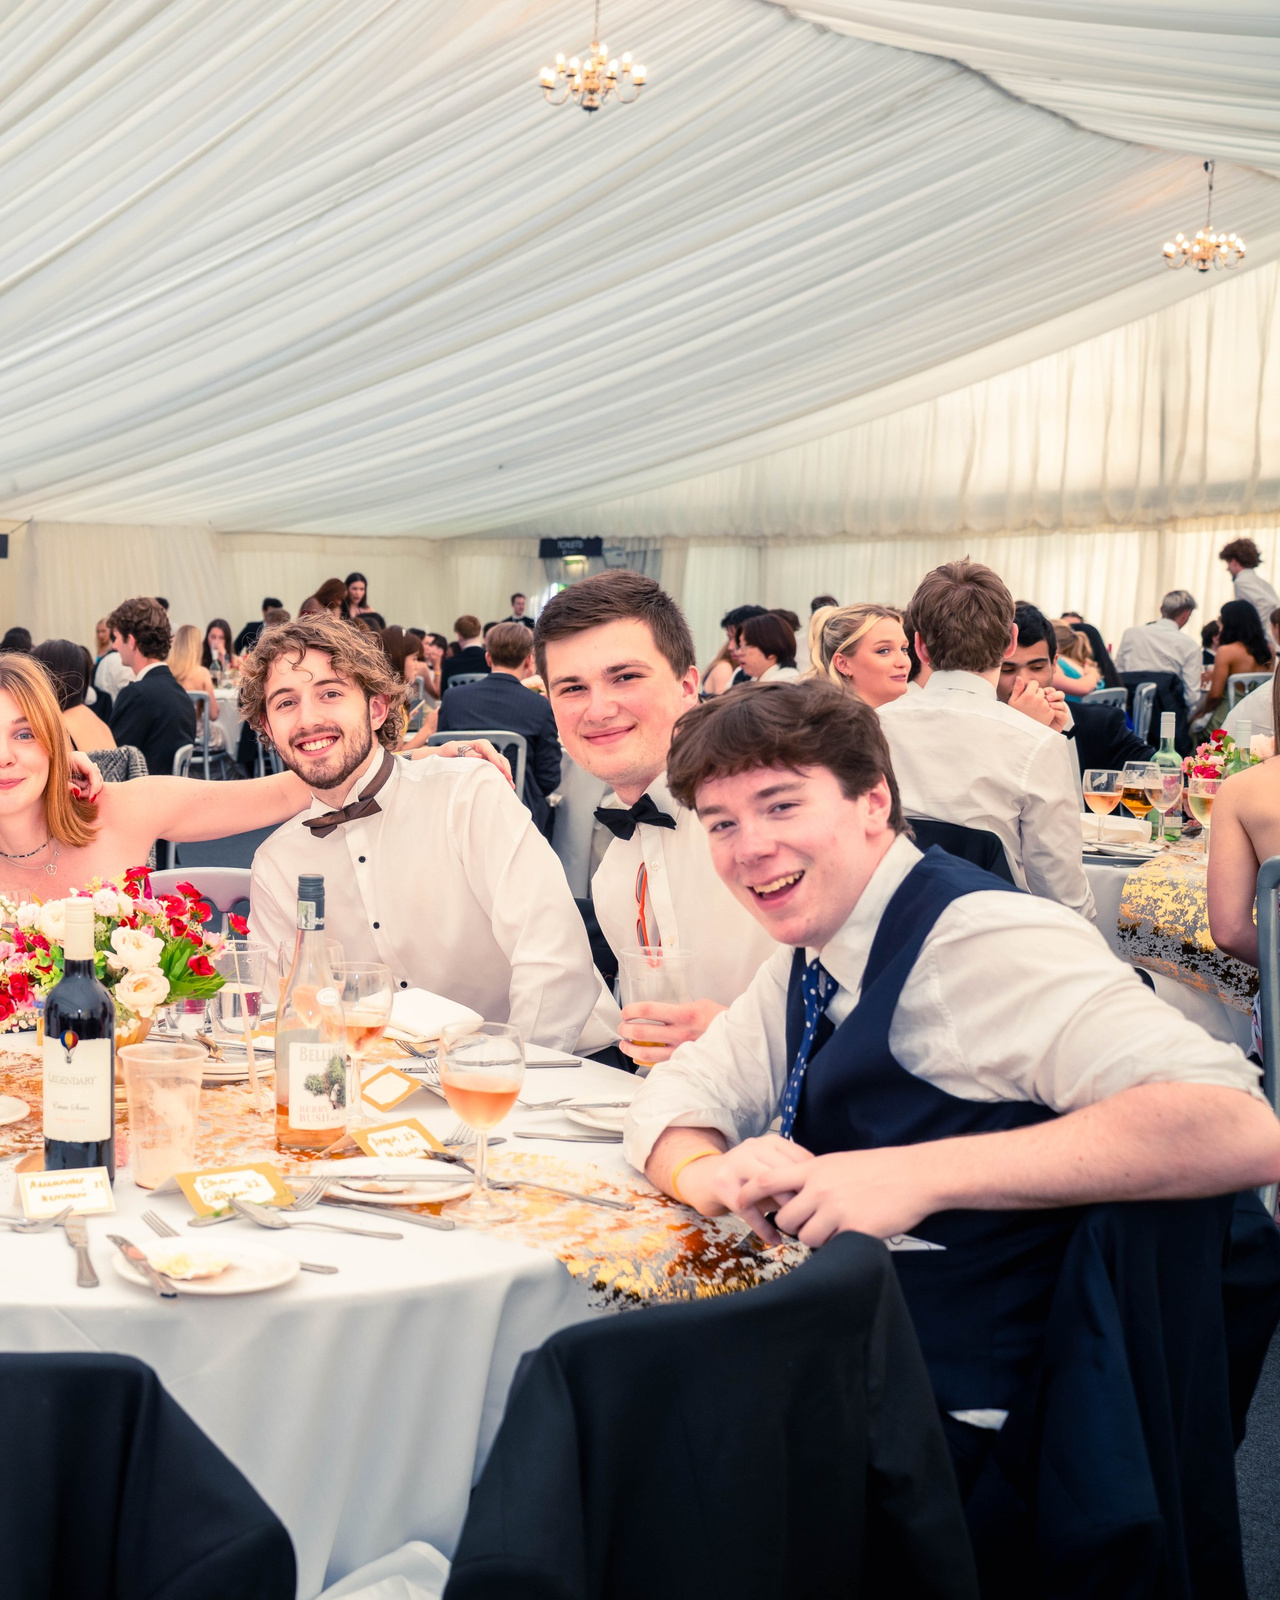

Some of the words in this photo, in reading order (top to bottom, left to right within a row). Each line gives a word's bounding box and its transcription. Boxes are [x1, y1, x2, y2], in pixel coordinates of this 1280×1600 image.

[557, 540, 584, 549] TOILETS
[47, 1071, 97, 1086] LEGENDARY
[299, 1104, 329, 1113] BERRY
[299, 1113, 330, 1123] BUSH
